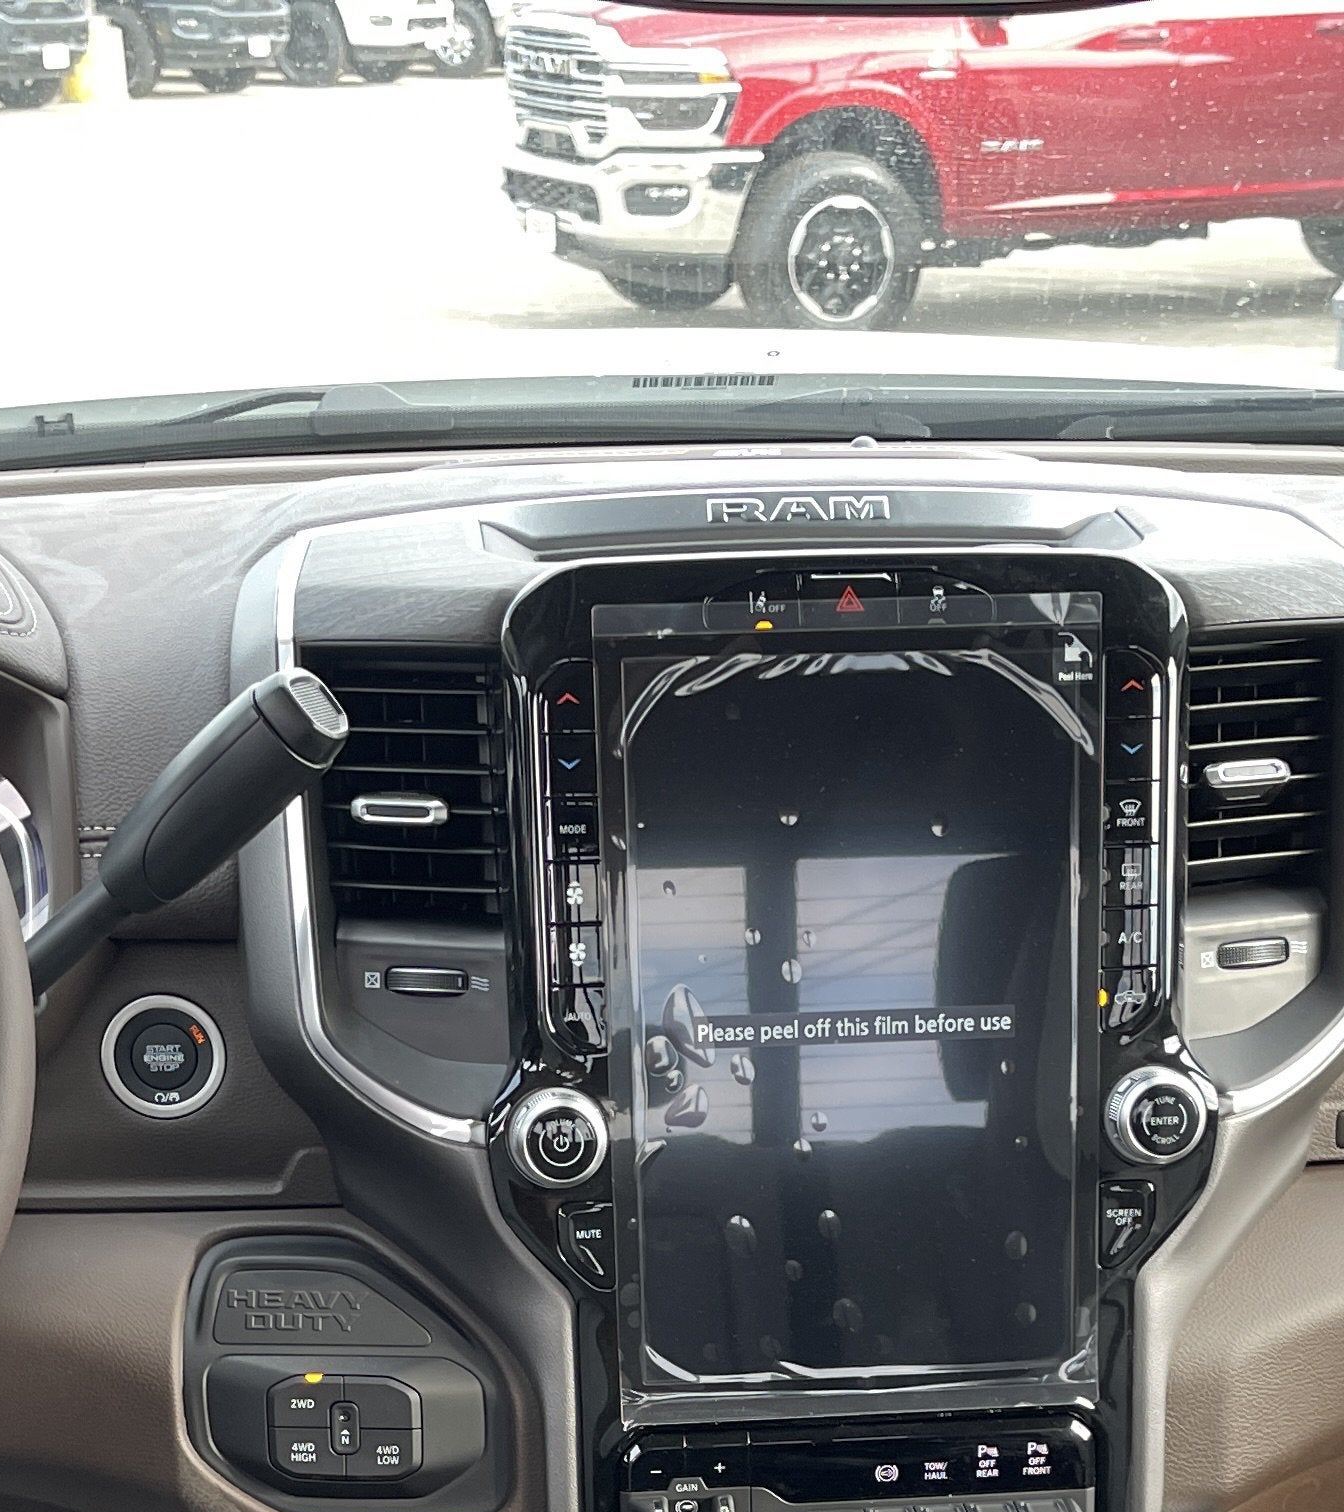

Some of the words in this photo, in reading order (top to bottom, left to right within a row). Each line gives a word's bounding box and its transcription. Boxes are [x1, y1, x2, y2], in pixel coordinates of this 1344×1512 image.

[706, 495, 890, 523] RAM
[768, 603, 786, 613] OFF
[929, 602, 948, 612] OFF
[1116, 817, 1146, 828] FRONT
[559, 824, 587, 834] MODE
[1119, 881, 1143, 891] REAR
[1118, 931, 1143, 945] A/C
[566, 1011, 592, 1022] AUTO
[697, 1023, 755, 1043] Please
[760, 1020, 799, 1043] peel
[804, 1018, 832, 1039] off
[835, 1016, 869, 1038] this
[873, 1015, 909, 1036] film
[914, 1013, 975, 1034] before
[980, 1014, 1012, 1031] use
[146, 1044, 181, 1053] START
[143, 1053, 185, 1062] ENGINE
[150, 1063, 180, 1072] STOP
[1154, 1096, 1176, 1106] TUNE
[547, 1118, 576, 1130] OLUME
[1150, 1115, 1180, 1126] ENTER
[1150, 1133, 1181, 1145] SCROLL
[1106, 1208, 1142, 1218] SCREEN
[1115, 1217, 1133, 1226] OFF
[576, 1229, 602, 1240] MUTE
[227, 1288, 369, 1310] HEAVY
[244, 1312, 362, 1332] DUTY
[290, 1399, 315, 1409] 2WD
[341, 1436, 350, 1445] N
[291, 1442, 315, 1452] 4WD
[376, 1445, 400, 1455] 4WD
[290, 1452, 316, 1463] HIGH
[377, 1455, 400, 1465] LOW
[1028, 1456, 1046, 1465] OFF
[924, 1462, 949, 1471] TOW/
[978, 1459, 997, 1468] OFF
[976, 1469, 999, 1478] REAR
[1022, 1466, 1052, 1475] FRONT
[924, 1472, 949, 1480] HAUL
[676, 1483, 698, 1493] GAIN
